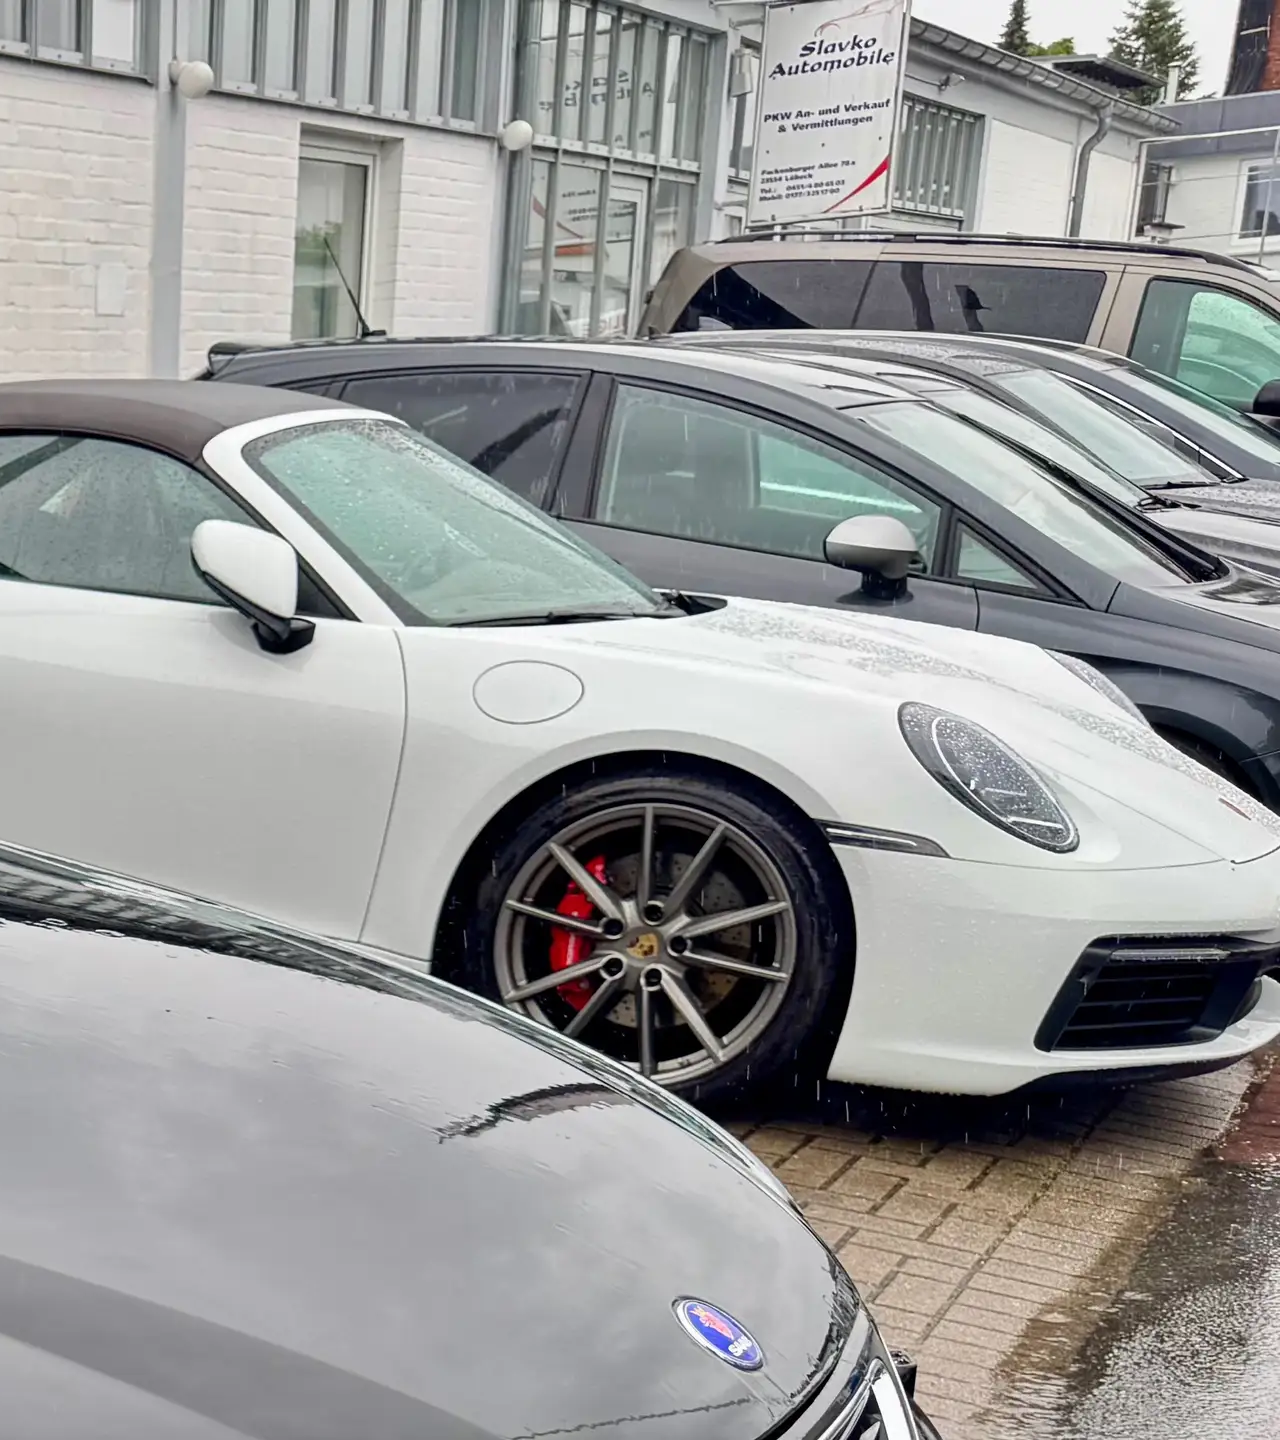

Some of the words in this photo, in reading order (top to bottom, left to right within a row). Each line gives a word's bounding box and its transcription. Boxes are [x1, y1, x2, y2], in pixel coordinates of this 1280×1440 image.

[798, 34, 878, 58] Slavko
[768, 48, 896, 79] Automobile
[763, 111, 792, 123] PKW
[794, 108, 815, 120] An-
[818, 105, 840, 117] und
[844, 98, 891, 112] Verkauf
[777, 123, 787, 133] &
[791, 115, 873, 133] Vermittlungen
